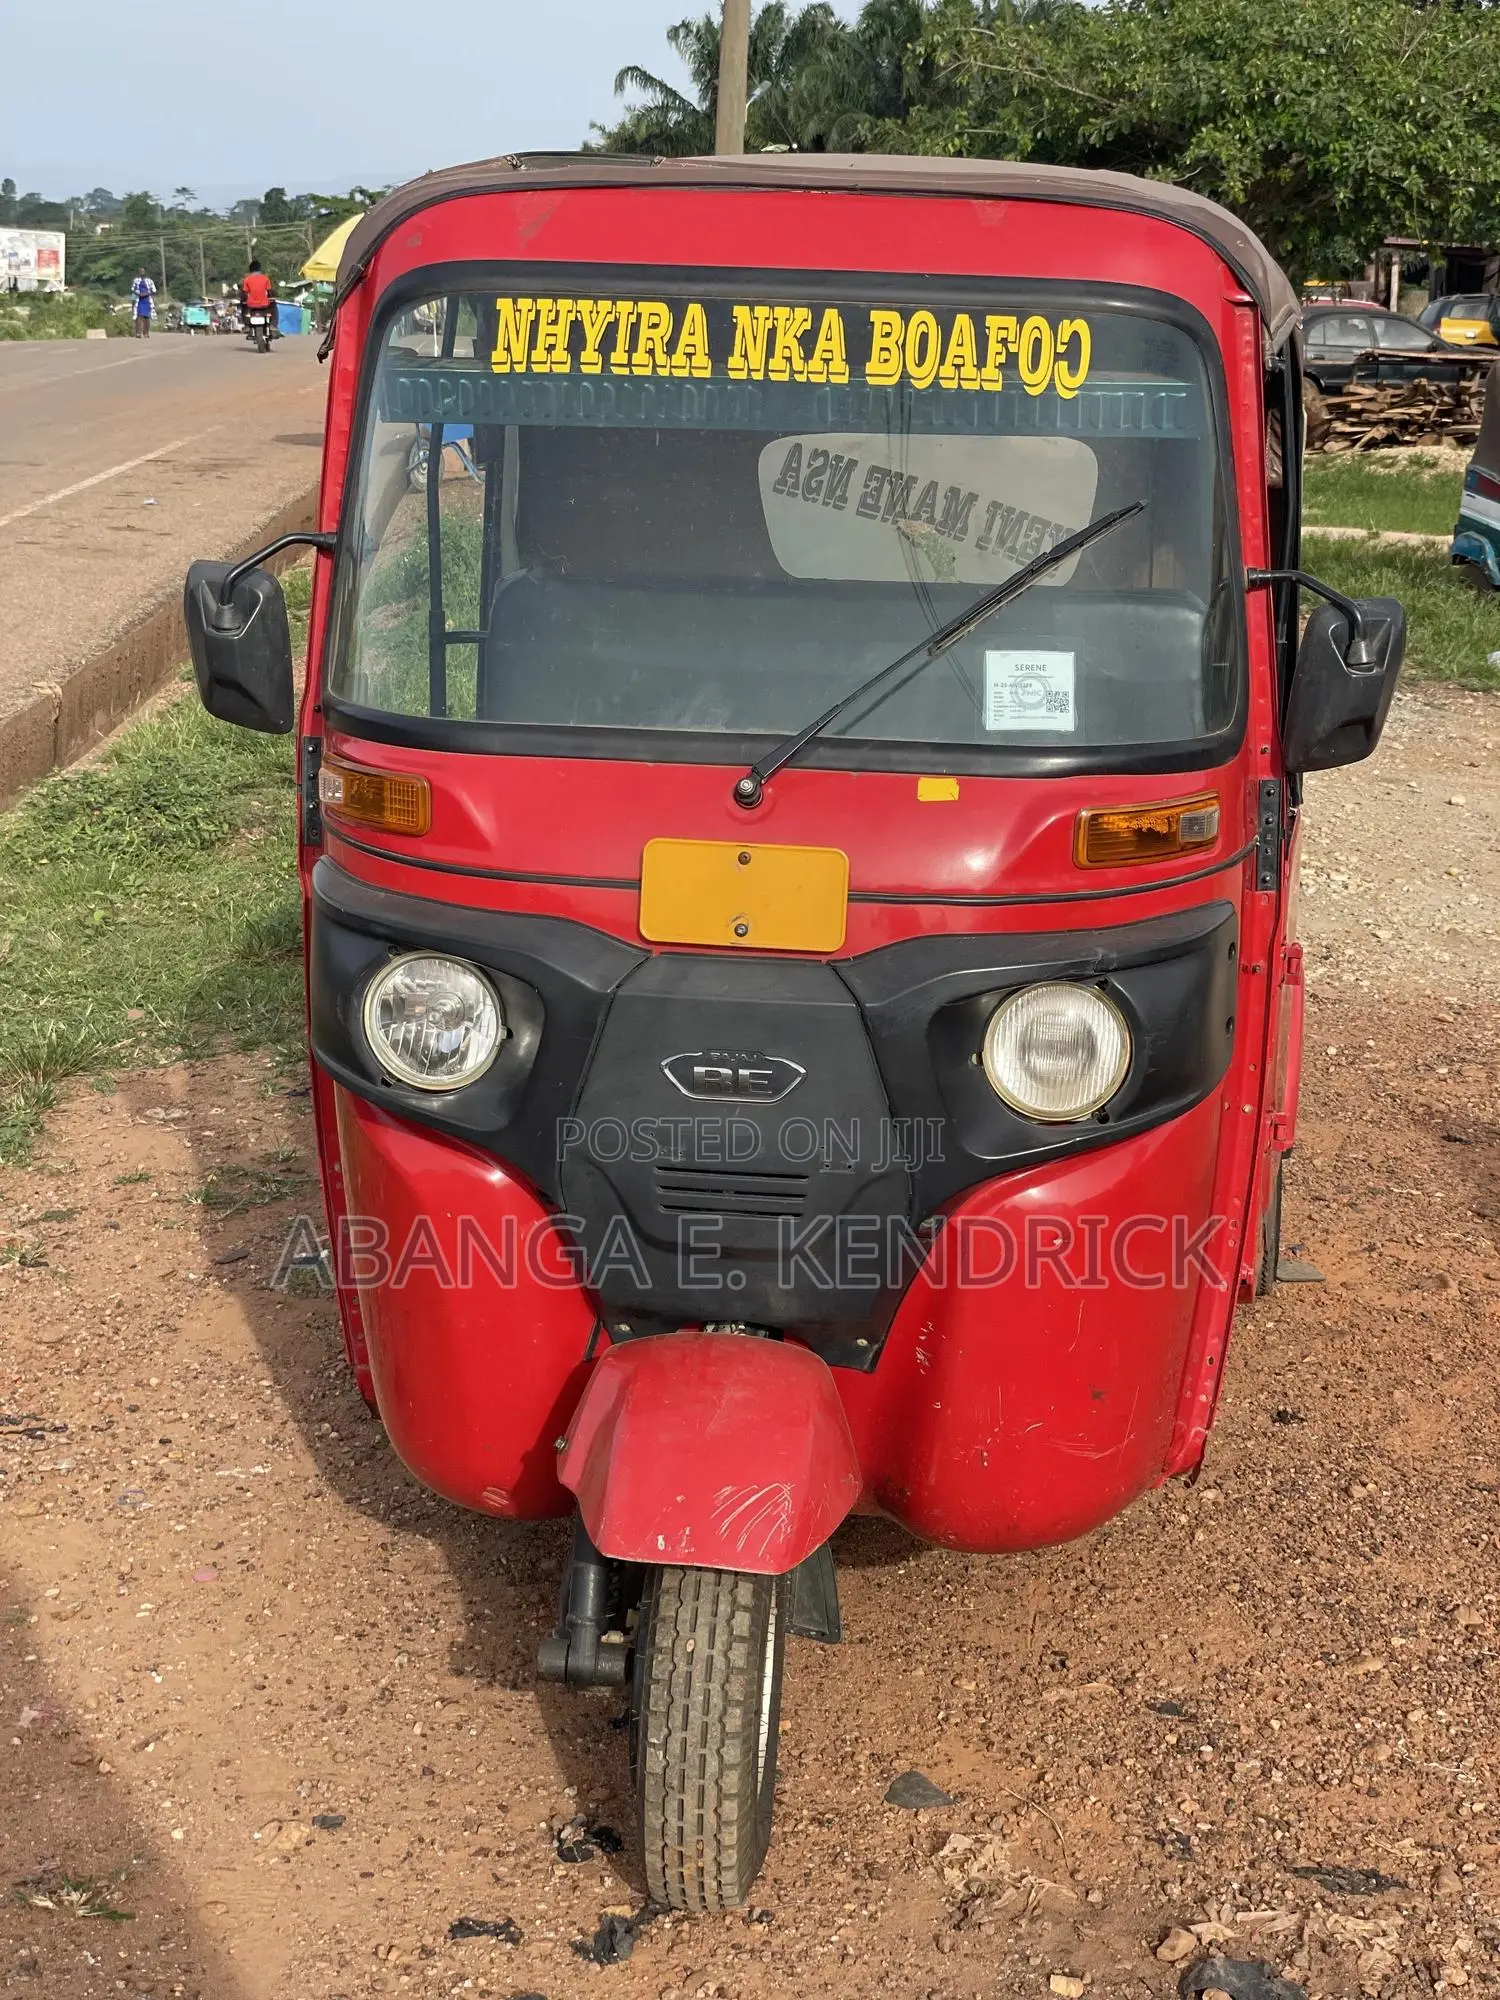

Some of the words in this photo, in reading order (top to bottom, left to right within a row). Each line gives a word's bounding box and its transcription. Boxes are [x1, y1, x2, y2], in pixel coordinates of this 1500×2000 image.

[491, 298, 712, 378] NHYIRA
[727, 305, 849, 384] NKA
[1014, 663, 1048, 672] SERENE
[693, 1066, 773, 1094] RE
